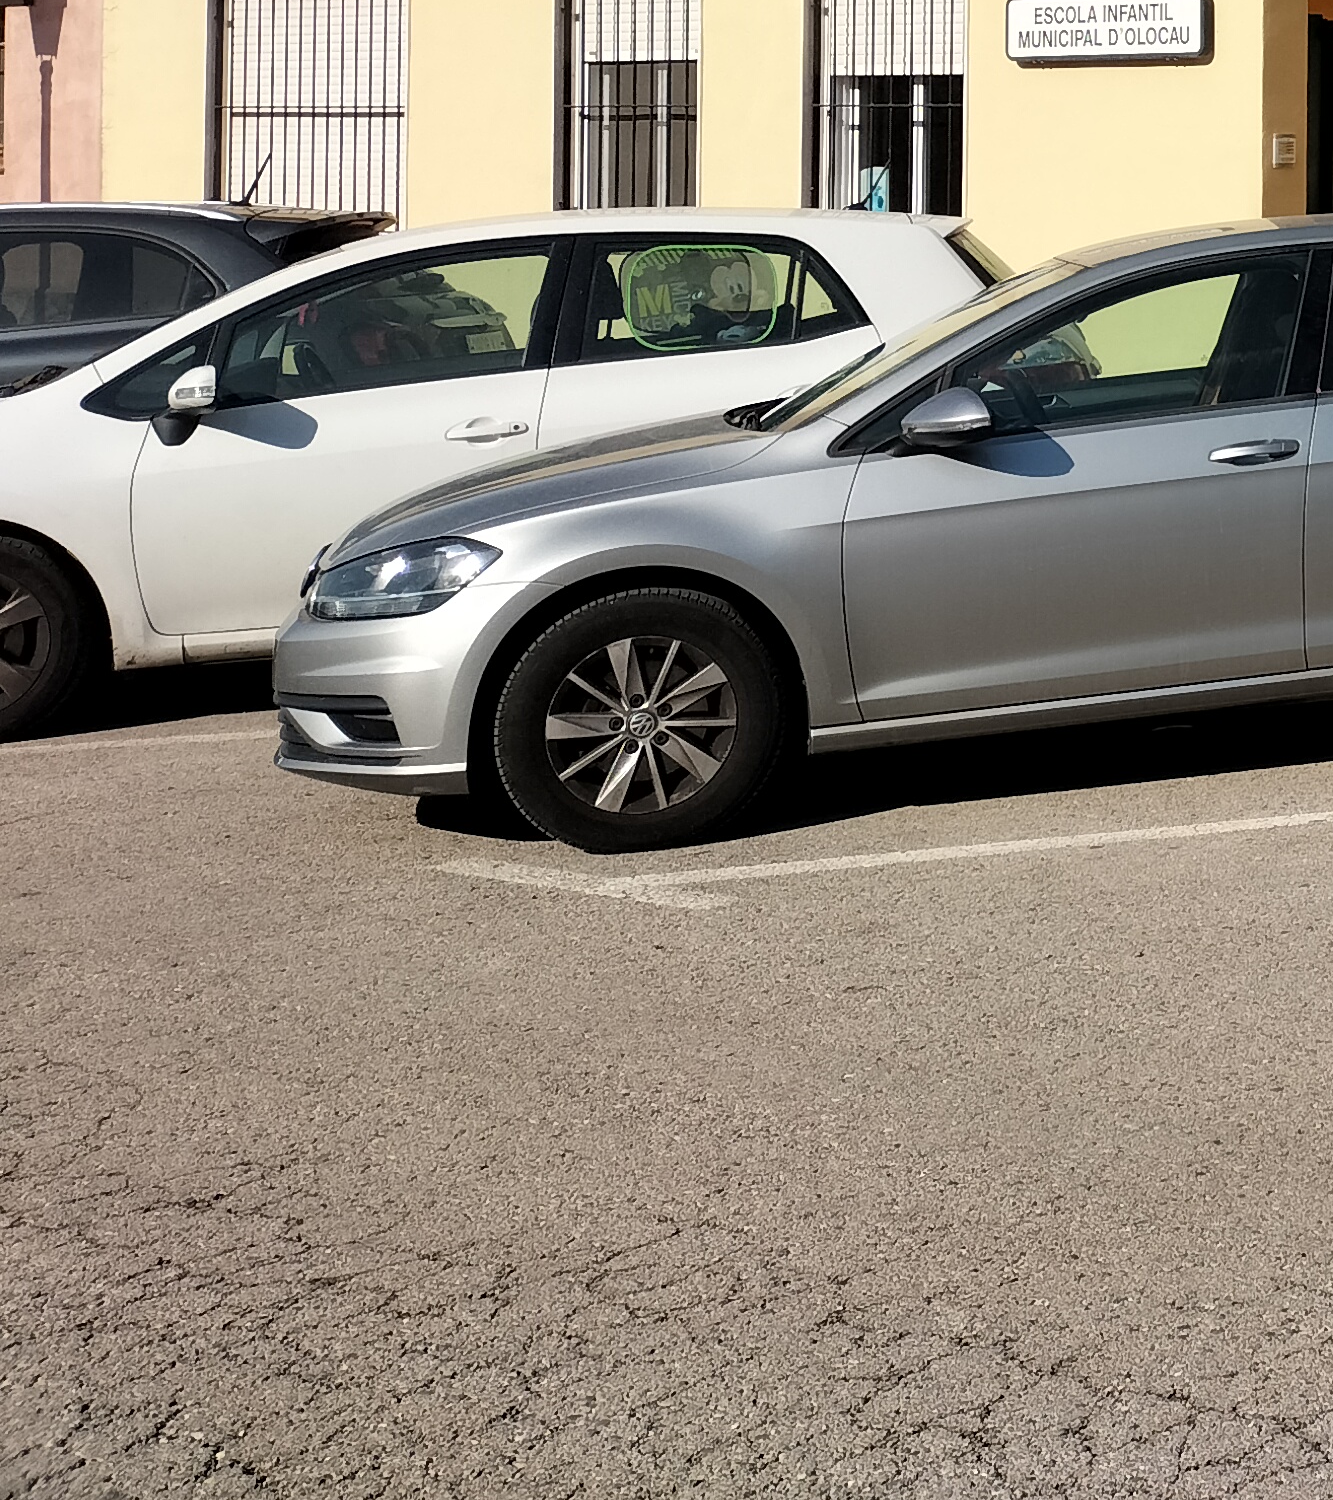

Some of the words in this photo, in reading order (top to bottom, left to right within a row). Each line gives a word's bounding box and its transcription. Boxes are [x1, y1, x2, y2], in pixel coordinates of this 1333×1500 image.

[1034, 5, 1098, 25] ESCOLA
[1102, 3, 1174, 23] INFANTIL
[1018, 28, 1103, 49] MUNICIPAL
[1108, 26, 1190, 46] D'OLOCAU
